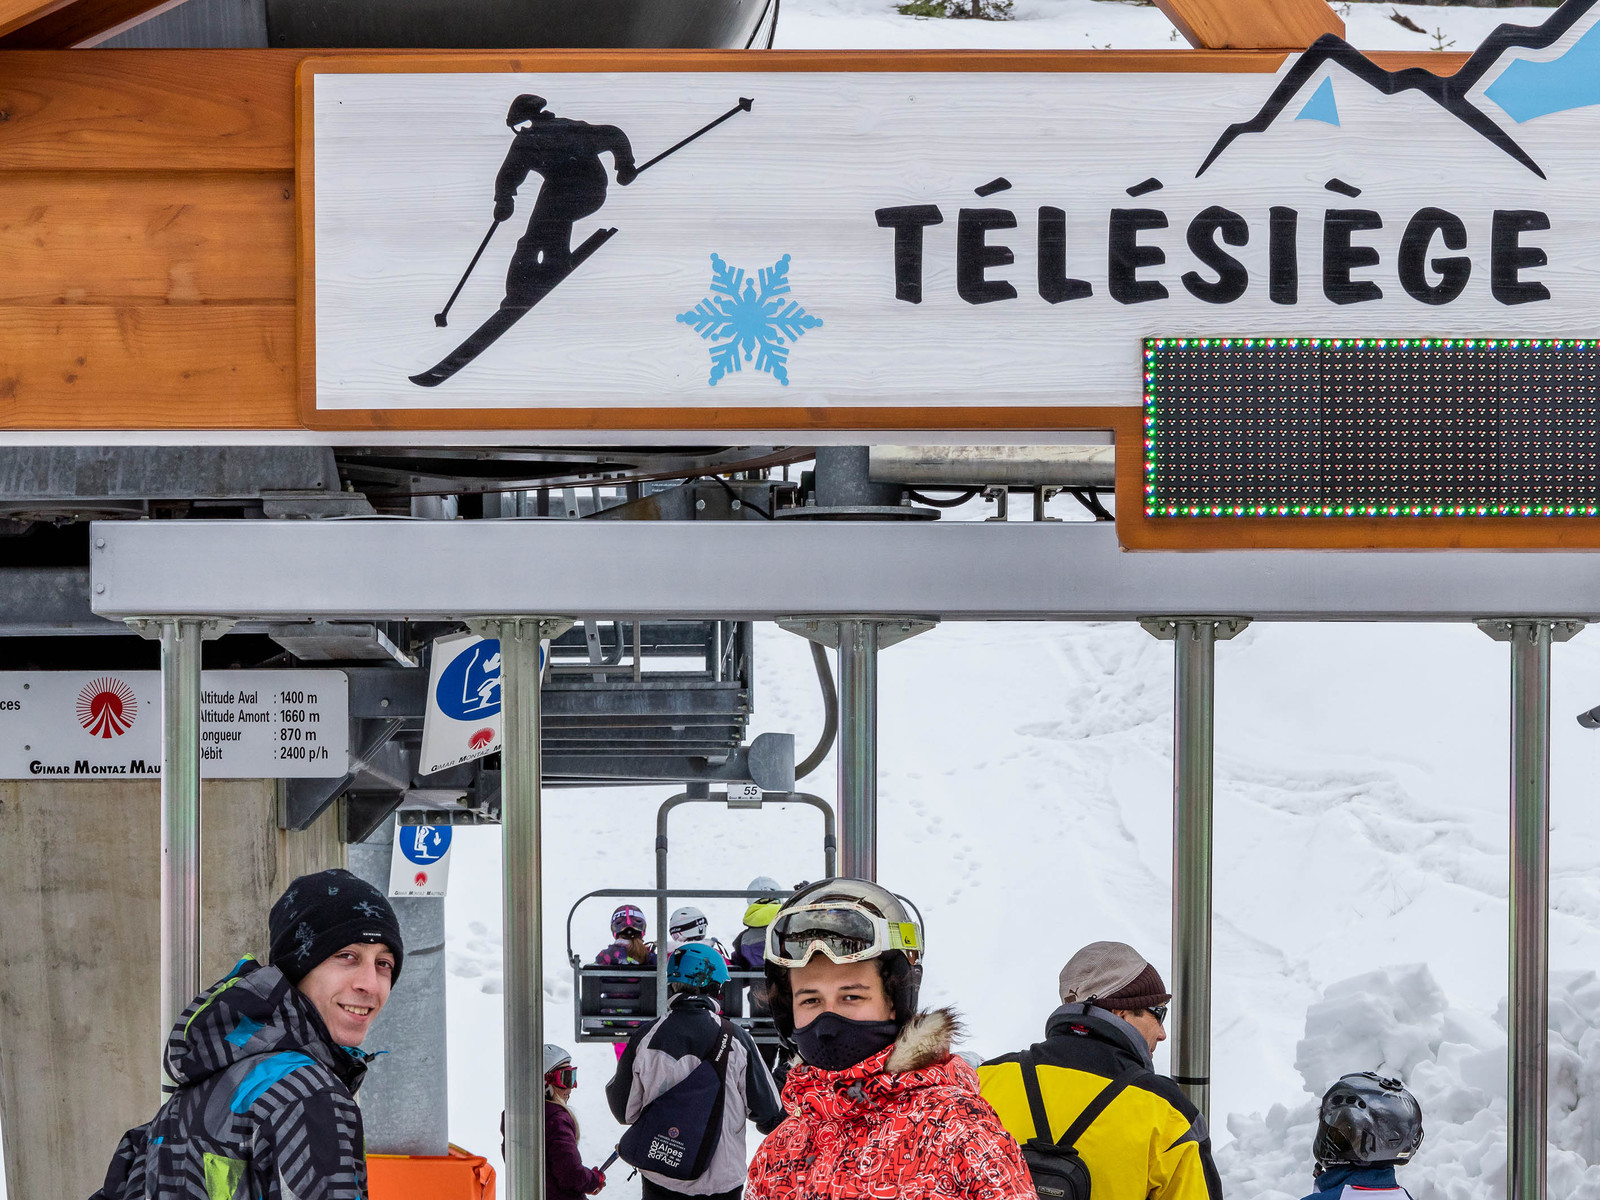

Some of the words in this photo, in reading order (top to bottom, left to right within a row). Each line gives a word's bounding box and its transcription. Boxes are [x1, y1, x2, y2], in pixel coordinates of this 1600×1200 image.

[875, 177, 1551, 306] TÉLÉSIÈGE
[238, 690, 258, 704] Aval
[280, 691, 304, 704] 1400
[307, 693, 318, 704] m
[238, 709, 270, 722] Amont
[280, 709, 305, 723] 1660
[309, 712, 320, 722] m
[200, 731, 242, 744] ongueur
[280, 728, 301, 741] 870
[305, 731, 317, 741] m
[280, 746, 306, 760] 2400
[309, 746, 329, 762] p/h
[743, 786, 758, 796] 55
[658, 1143, 684, 1159] Alpes
